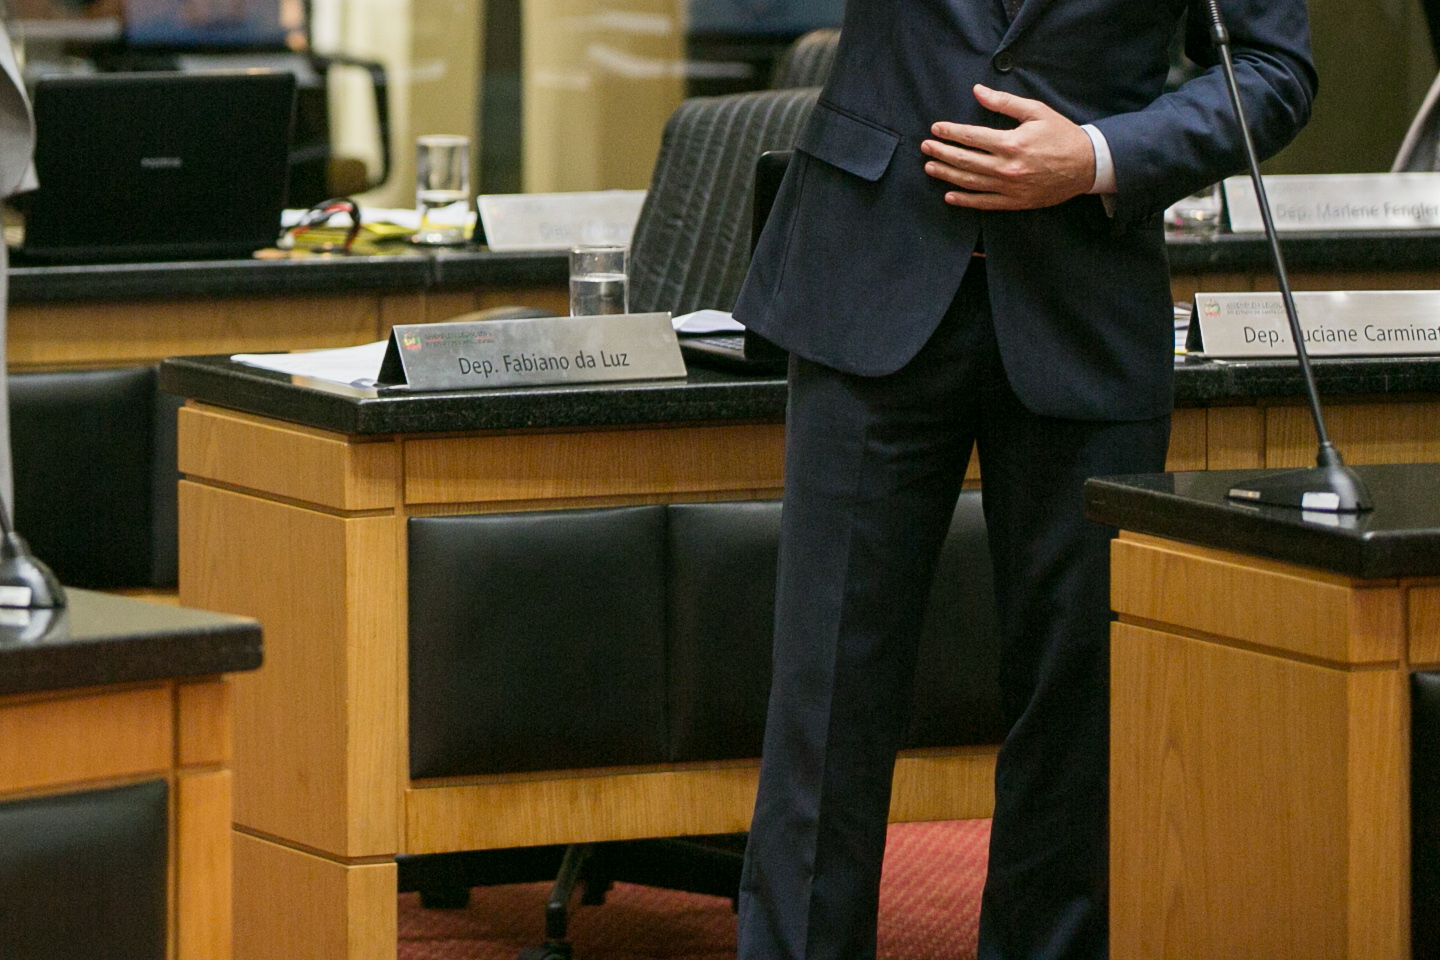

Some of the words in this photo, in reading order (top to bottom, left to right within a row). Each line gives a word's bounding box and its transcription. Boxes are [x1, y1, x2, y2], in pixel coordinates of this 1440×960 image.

[1243, 326, 1285, 348] Dep.
[1295, 325, 1358, 342] uciane
[458, 355, 499, 378] Dep.
[503, 353, 570, 373] Fabiano
[575, 351, 596, 370] da
[600, 349, 630, 368] Luz
